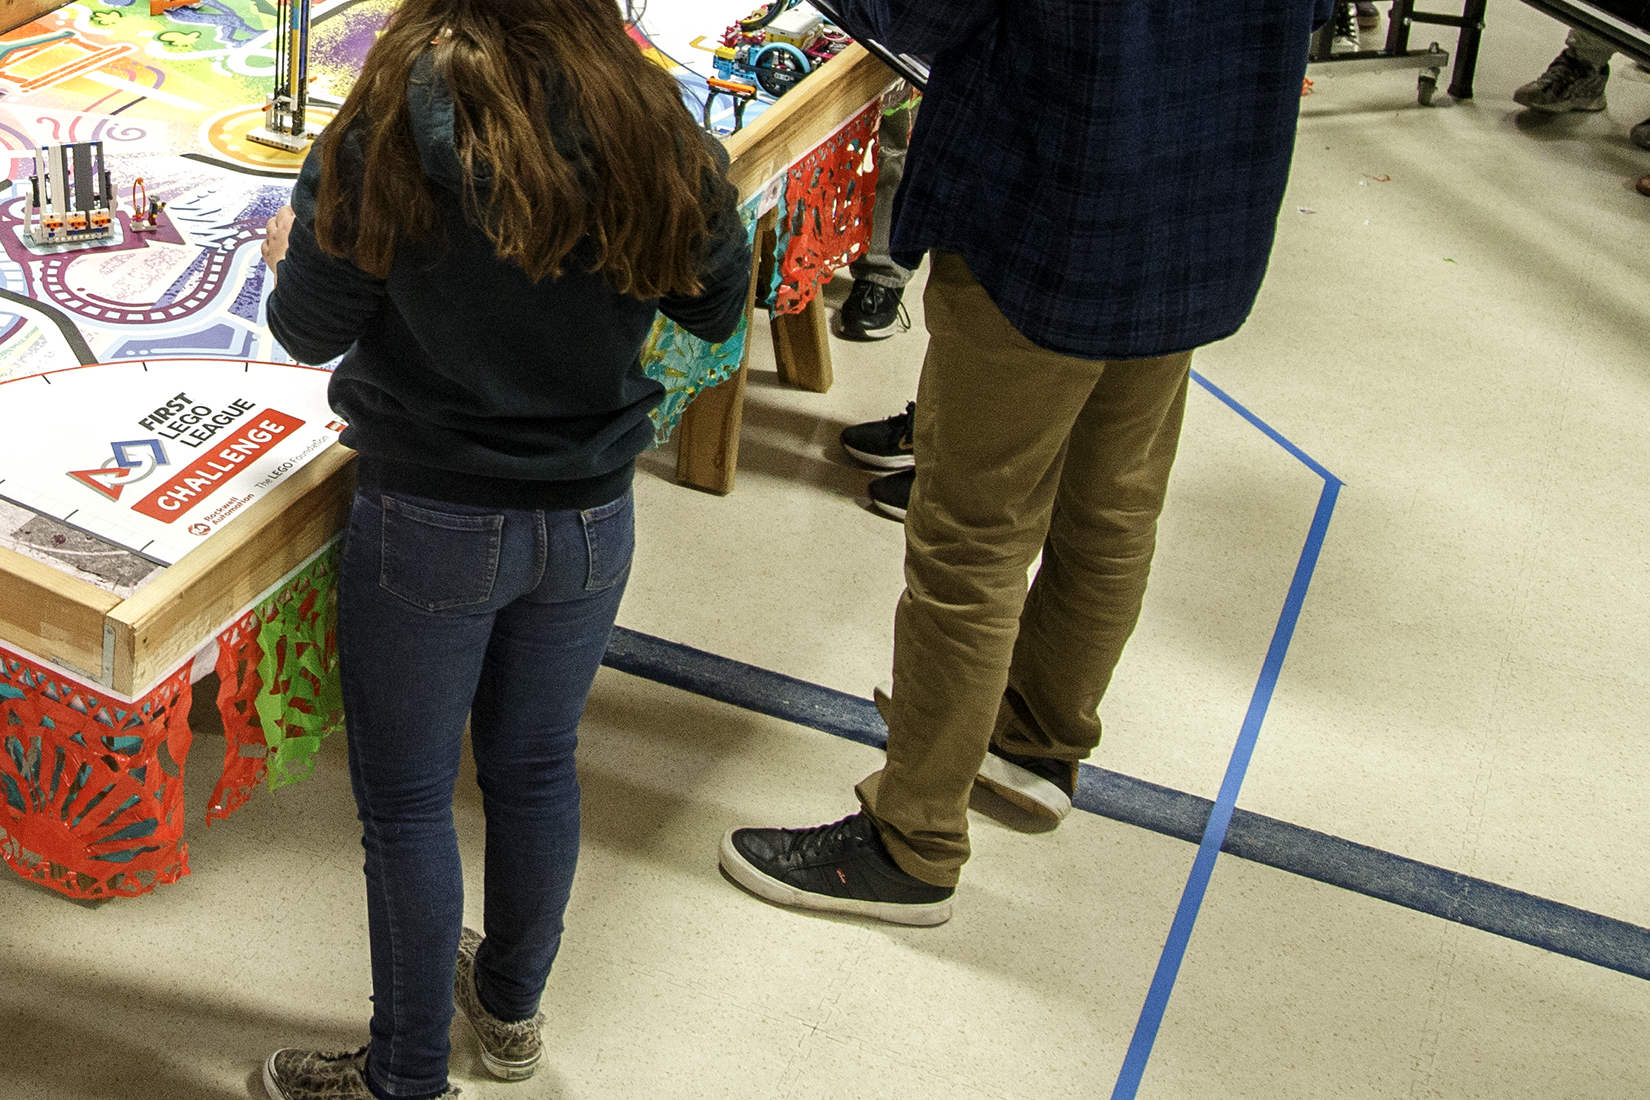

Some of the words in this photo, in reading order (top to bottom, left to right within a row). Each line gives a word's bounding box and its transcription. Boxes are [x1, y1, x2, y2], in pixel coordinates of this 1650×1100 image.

[138, 392, 193, 432] FIRST
[157, 405, 212, 440] LEGO
[180, 398, 256, 448] LEAGUE
[157, 419, 285, 511] CHALLENGE
[254, 478, 273, 490] The
[269, 462, 293, 480] LEGO
[292, 435, 329, 465] Foundation
[204, 496, 238, 521] Rockwell
[212, 492, 255, 525] Automation
